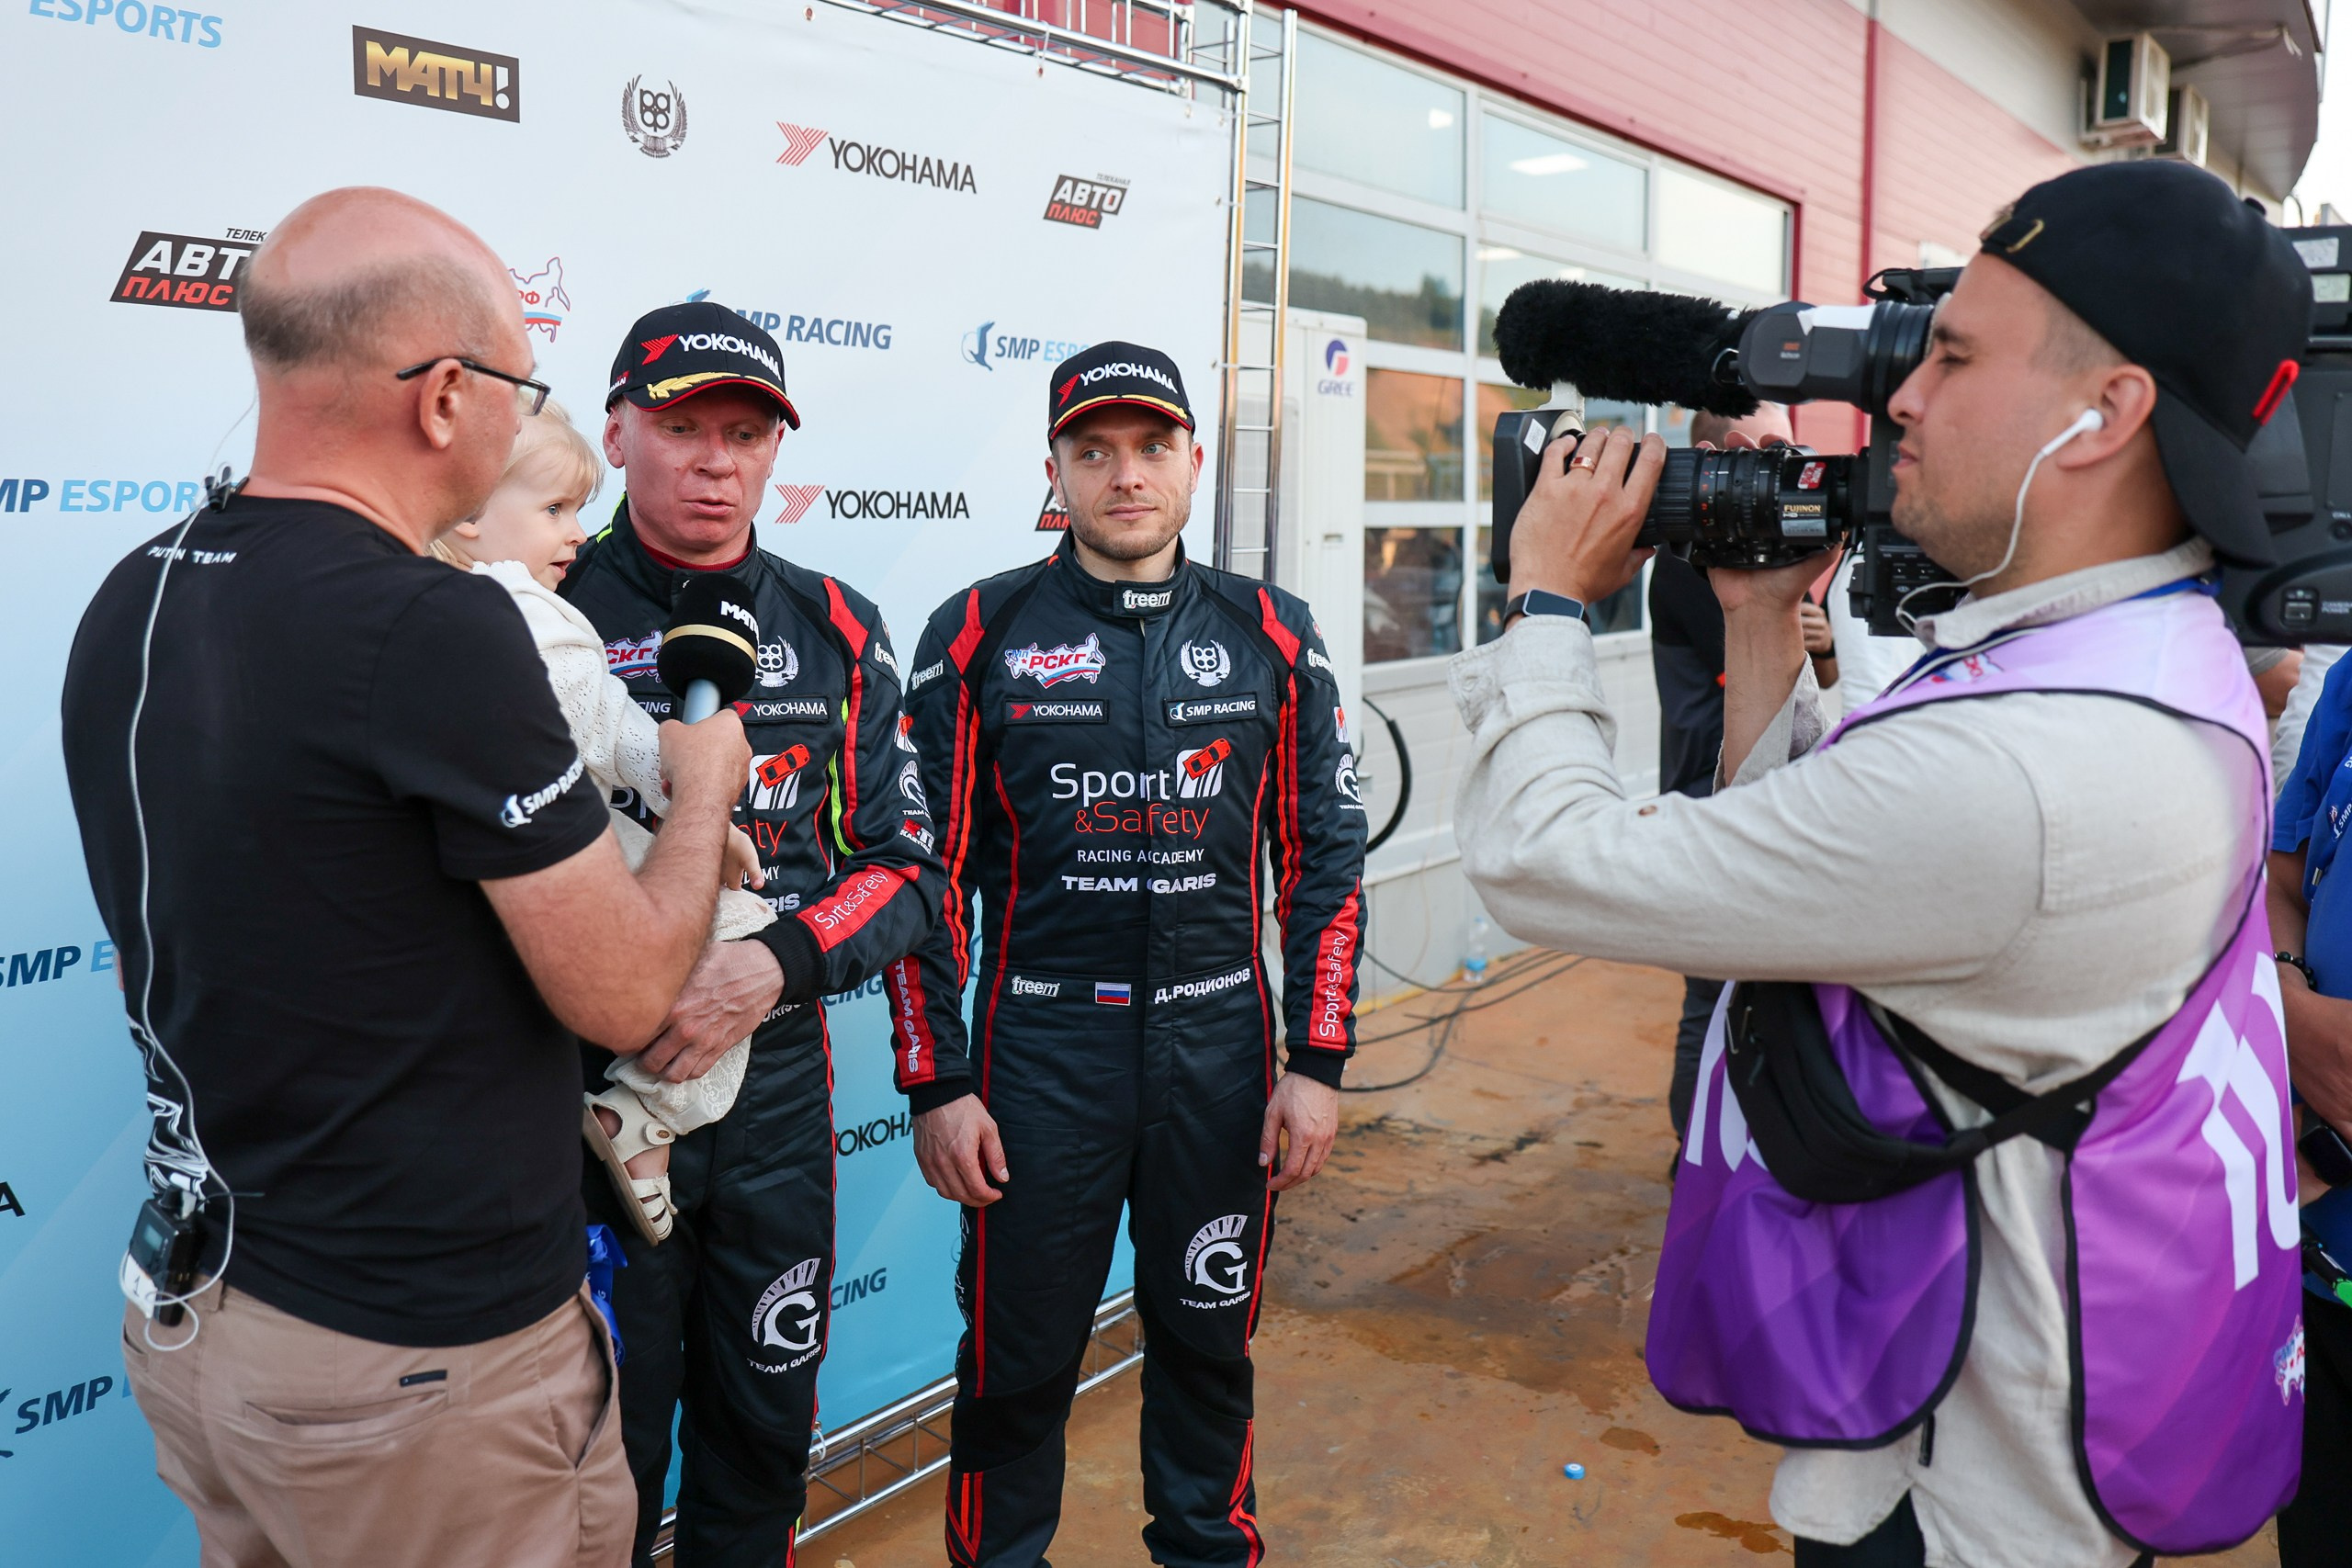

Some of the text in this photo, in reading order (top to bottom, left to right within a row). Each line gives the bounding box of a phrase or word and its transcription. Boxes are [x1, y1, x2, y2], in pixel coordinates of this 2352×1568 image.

[366, 41, 510, 109] МАТЧ!
[828, 137, 977, 194] YOKOHAMA
[1052, 178, 1123, 213] АВТО
[1047, 203, 1099, 225] ПЛЮС
[226, 228, 267, 241] ТЕЛЕК
[131, 240, 253, 281] АВТ
[121, 276, 234, 306] ПЛЮС
[736, 310, 892, 350] MP RACING
[678, 333, 783, 382] YOKOHAMA
[995, 335, 1040, 360] SMP
[1080, 362, 1179, 395] YOKOHAMA
[59, 479, 204, 513] ESPOR
[825, 490, 970, 519] YOKOHAMA
[1783, 504, 1822, 513] FUJINON
[147, 546, 237, 564] PUTN TEAM
[1122, 589, 1173, 609] freem
[606, 647, 653, 664] СКГ
[1028, 653, 1087, 670] РСКГ
[910, 659, 944, 691] freem
[753, 702, 828, 716] YOKOHAMA
[1033, 705, 1103, 716] YOKOHAMA
[1186, 700, 1256, 716] SMP RACING
[522, 783, 560, 815] SMP
[1050, 762, 1170, 807] Sport
[1074, 801, 1210, 840] &Safety
[1077, 848, 1205, 864] RACING ACADEMY
[1061, 873, 1216, 894] TEAM GARIS
[764, 893, 800, 914] RIS
[0, 945, 82, 988] MP
[895, 959, 914, 1017] TEAM
[1012, 975, 1060, 997] freem
[1154, 967, 1250, 1004] Д.РОДИОНОВ
[835, 1111, 913, 1156] OKOH
[830, 1267, 888, 1311] CING
[1180, 1298, 1217, 1310] TEAM
[747, 1358, 787, 1374] TEAM
[15, 1375, 113, 1435] SMP
